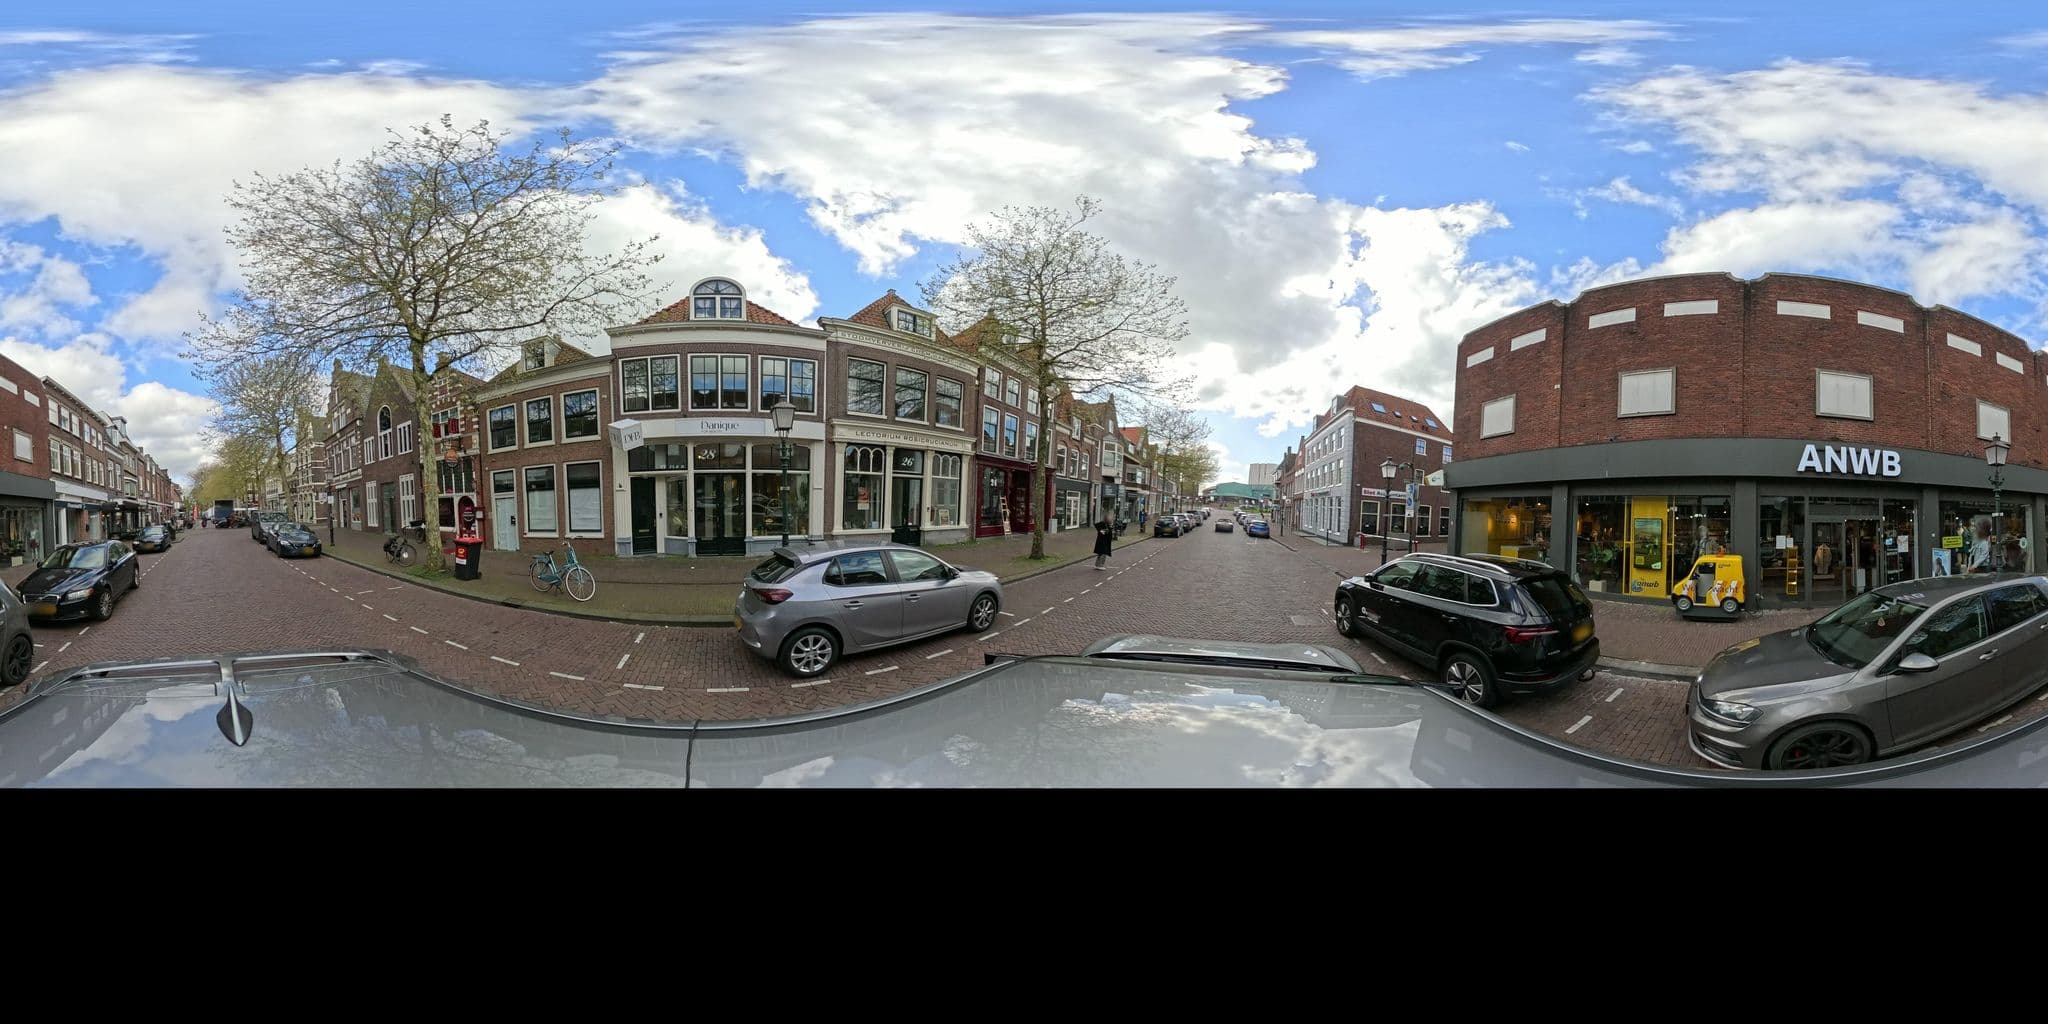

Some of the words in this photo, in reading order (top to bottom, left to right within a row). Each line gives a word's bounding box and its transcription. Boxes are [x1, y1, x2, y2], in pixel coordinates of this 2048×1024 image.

[700, 420, 739, 431] Danique
[855, 431, 901, 440] LECTORIUM
[701, 449, 717, 460] 28
[901, 457, 915, 467] 26
[1797, 444, 1902, 477] ANWB
